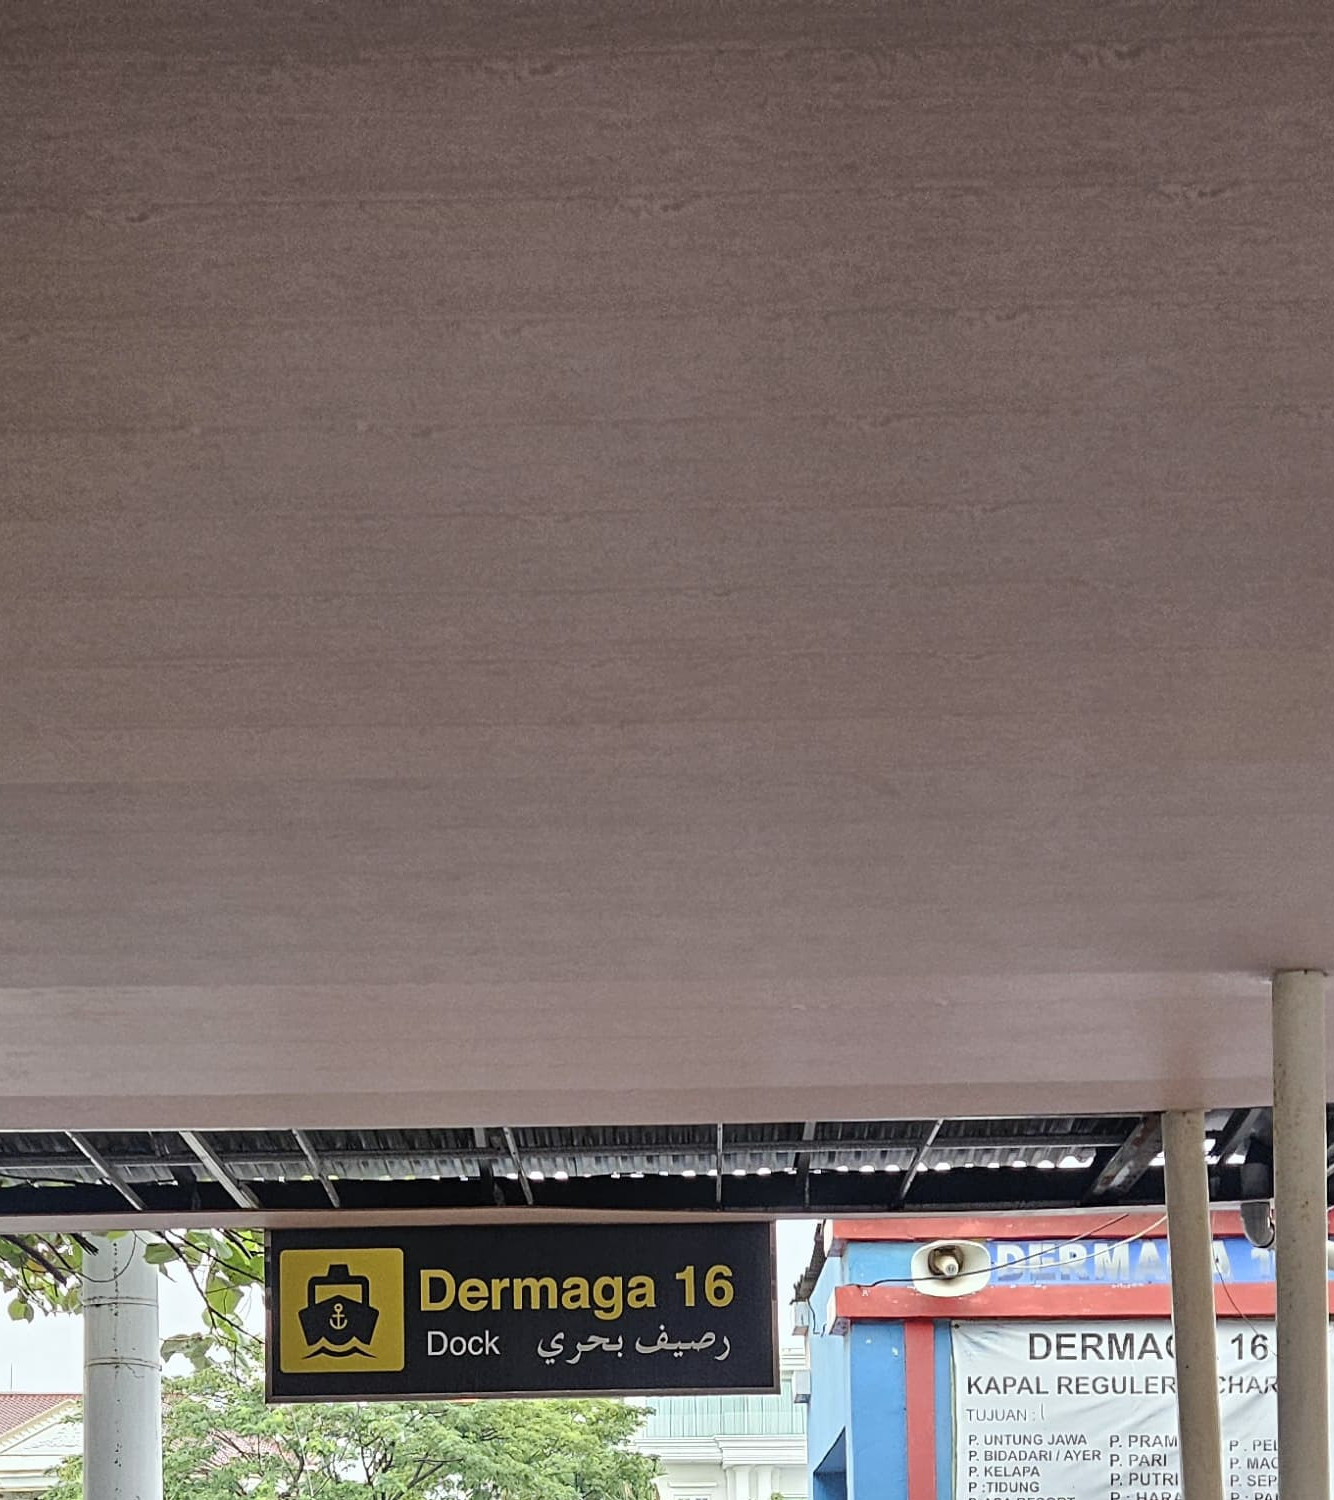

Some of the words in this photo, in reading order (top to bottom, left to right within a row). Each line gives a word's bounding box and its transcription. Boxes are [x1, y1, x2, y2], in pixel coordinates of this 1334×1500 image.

[997, 1241, 1233, 1282] DERMAA
[420, 1268, 656, 1320] Dermaga
[676, 1265, 734, 1307] 16
[427, 1330, 500, 1357] Dock
[536, 1329, 623, 1365] بحري
[635, 1324, 732, 1361] رصيف
[1028, 1332, 1218, 1360] DERMA
[1230, 1332, 1268, 1360] 16
[967, 1376, 1049, 1395] KAPAL
[1057, 1376, 1176, 1394] REGULER
[966, 1409, 1027, 1421] TUJUAN
[969, 1435, 979, 1445] P.
[984, 1434, 1043, 1446] UNTUNG
[1047, 1434, 1087, 1445] JAWA
[1110, 1435, 1123, 1448] P.
[1129, 1435, 1177, 1447] PRAM
[969, 1451, 980, 1461] P.
[984, 1450, 1053, 1461] BIDADARI
[1063, 1449, 1102, 1461] AYER
[1110, 1454, 1123, 1467] P.
[1129, 1454, 1167, 1467] PARI
[1230, 1458, 1242, 1470] P.
[969, 1466, 979, 1477] P.
[984, 1466, 1041, 1477] KELAPA
[1111, 1473, 1123, 1486] P.
[1230, 1475, 1242, 1487] P.
[1247, 1475, 1277, 1487] SEP
